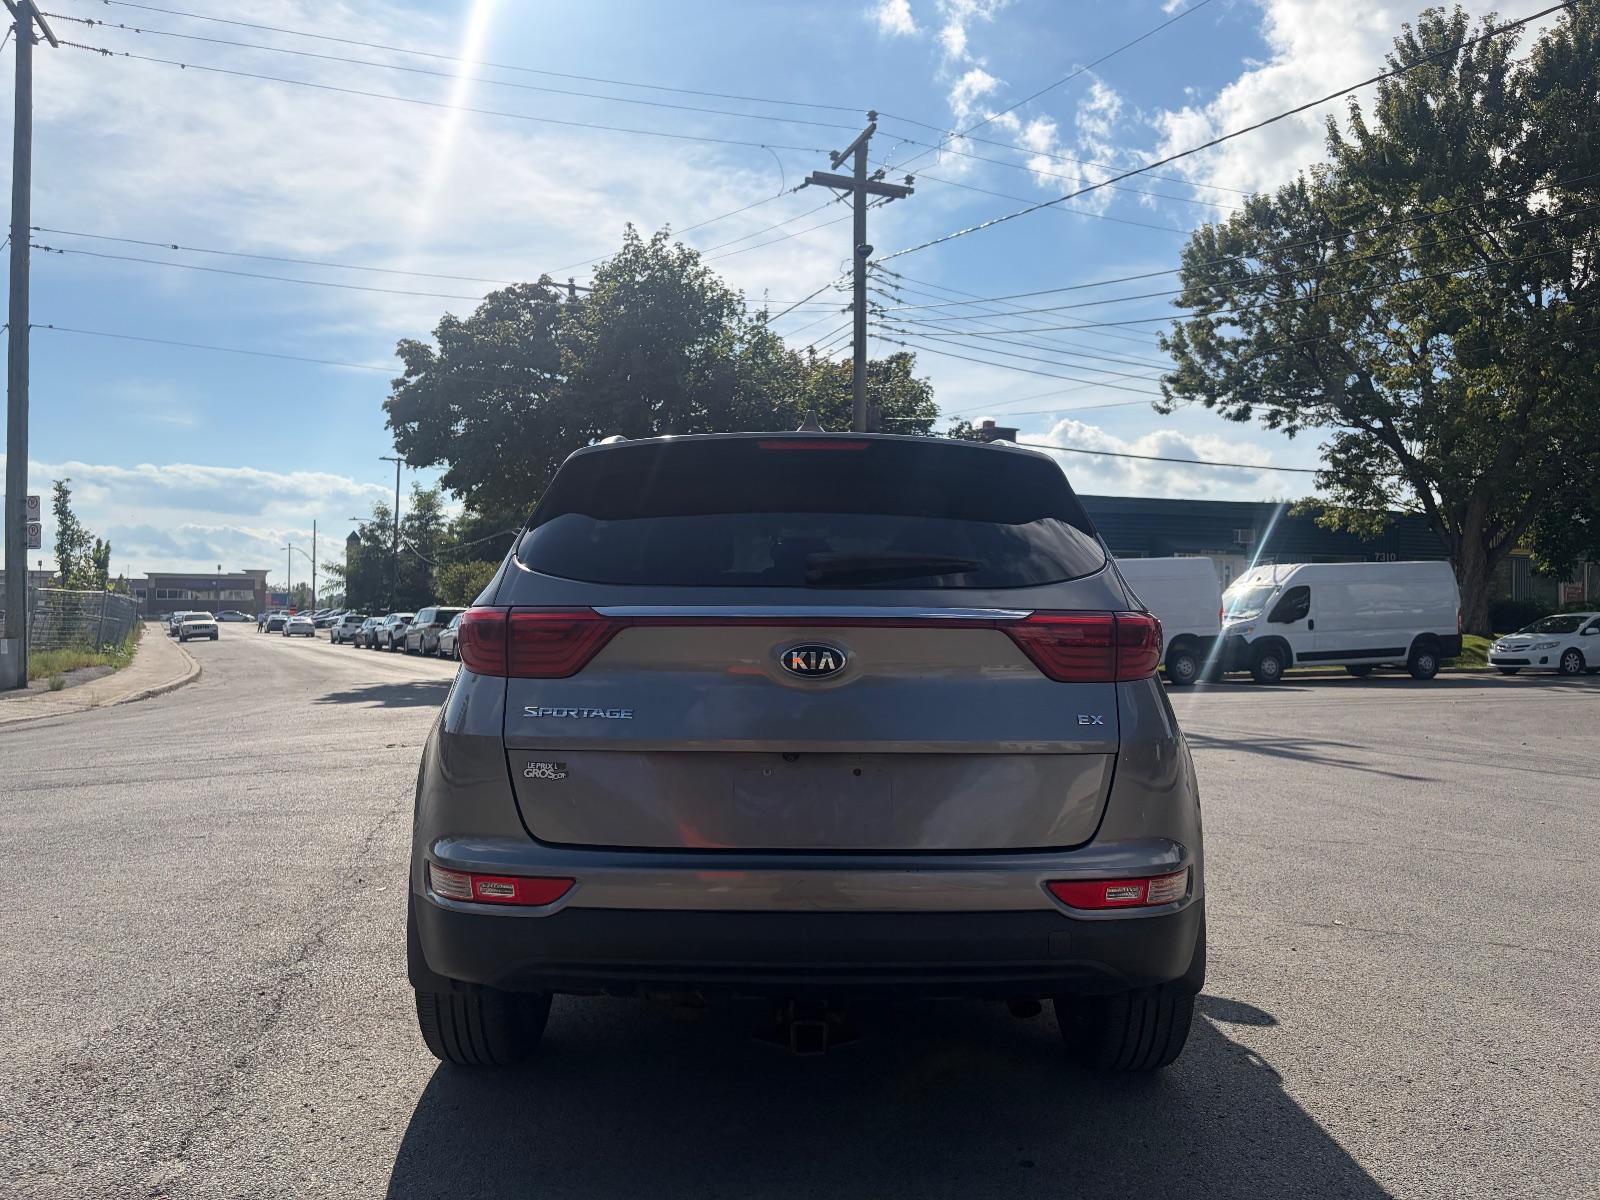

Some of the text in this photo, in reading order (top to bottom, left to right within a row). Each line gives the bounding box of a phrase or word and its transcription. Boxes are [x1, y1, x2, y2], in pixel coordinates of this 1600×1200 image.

[1374, 551, 1396, 562] 7310
[791, 651, 836, 670] KIA
[522, 706, 633, 719] SPORTAGE
[1077, 714, 1104, 725] EX
[527, 761, 536, 769] LE
[536, 762, 553, 770] PRIX
